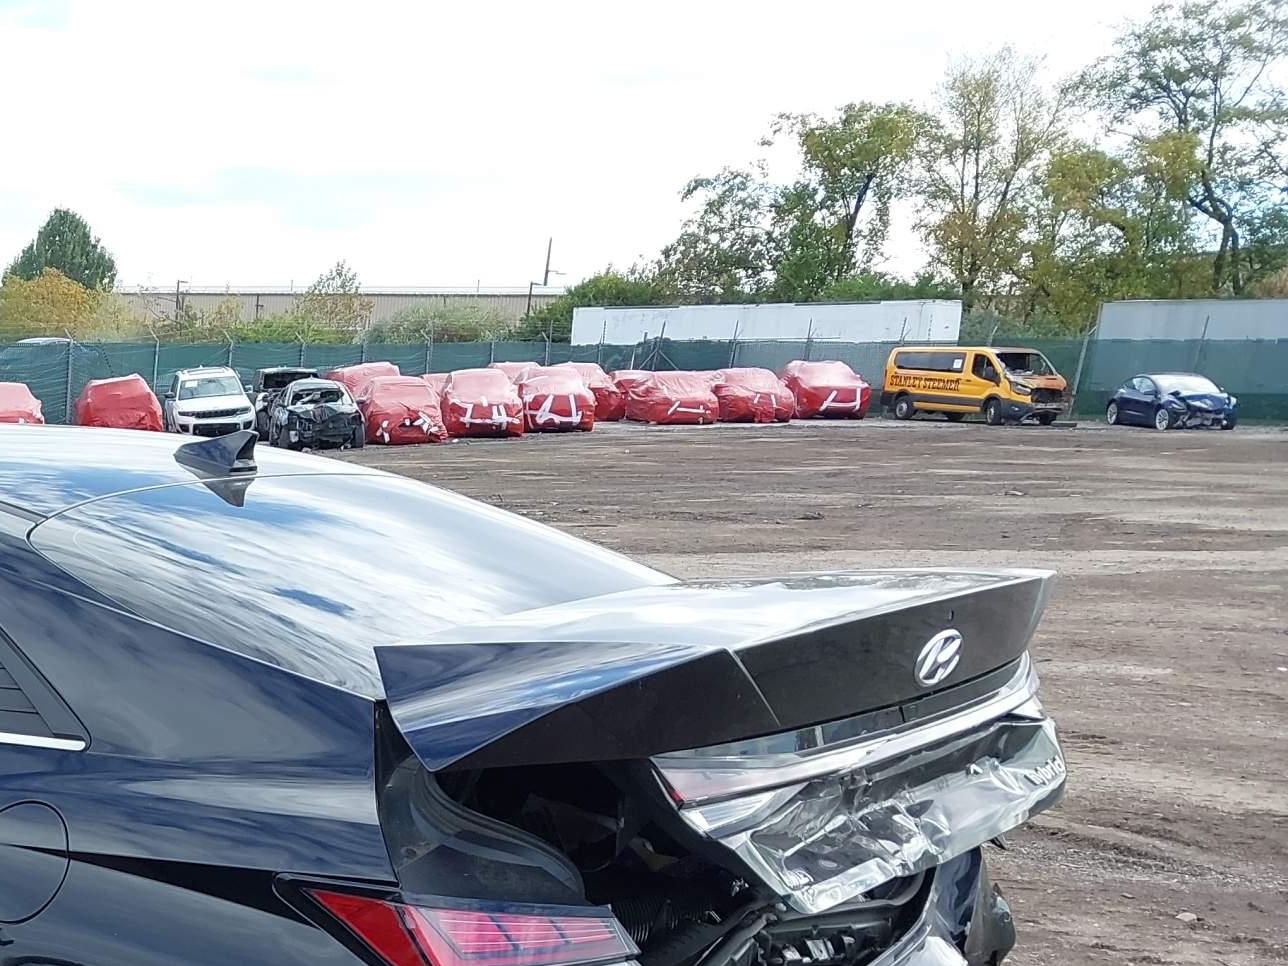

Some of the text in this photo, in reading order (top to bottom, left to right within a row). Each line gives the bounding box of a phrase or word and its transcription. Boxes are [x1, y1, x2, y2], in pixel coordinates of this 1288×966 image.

[890, 374, 960, 392] STANLEY STEEMER
[1023, 755, 1065, 786] hybrid
